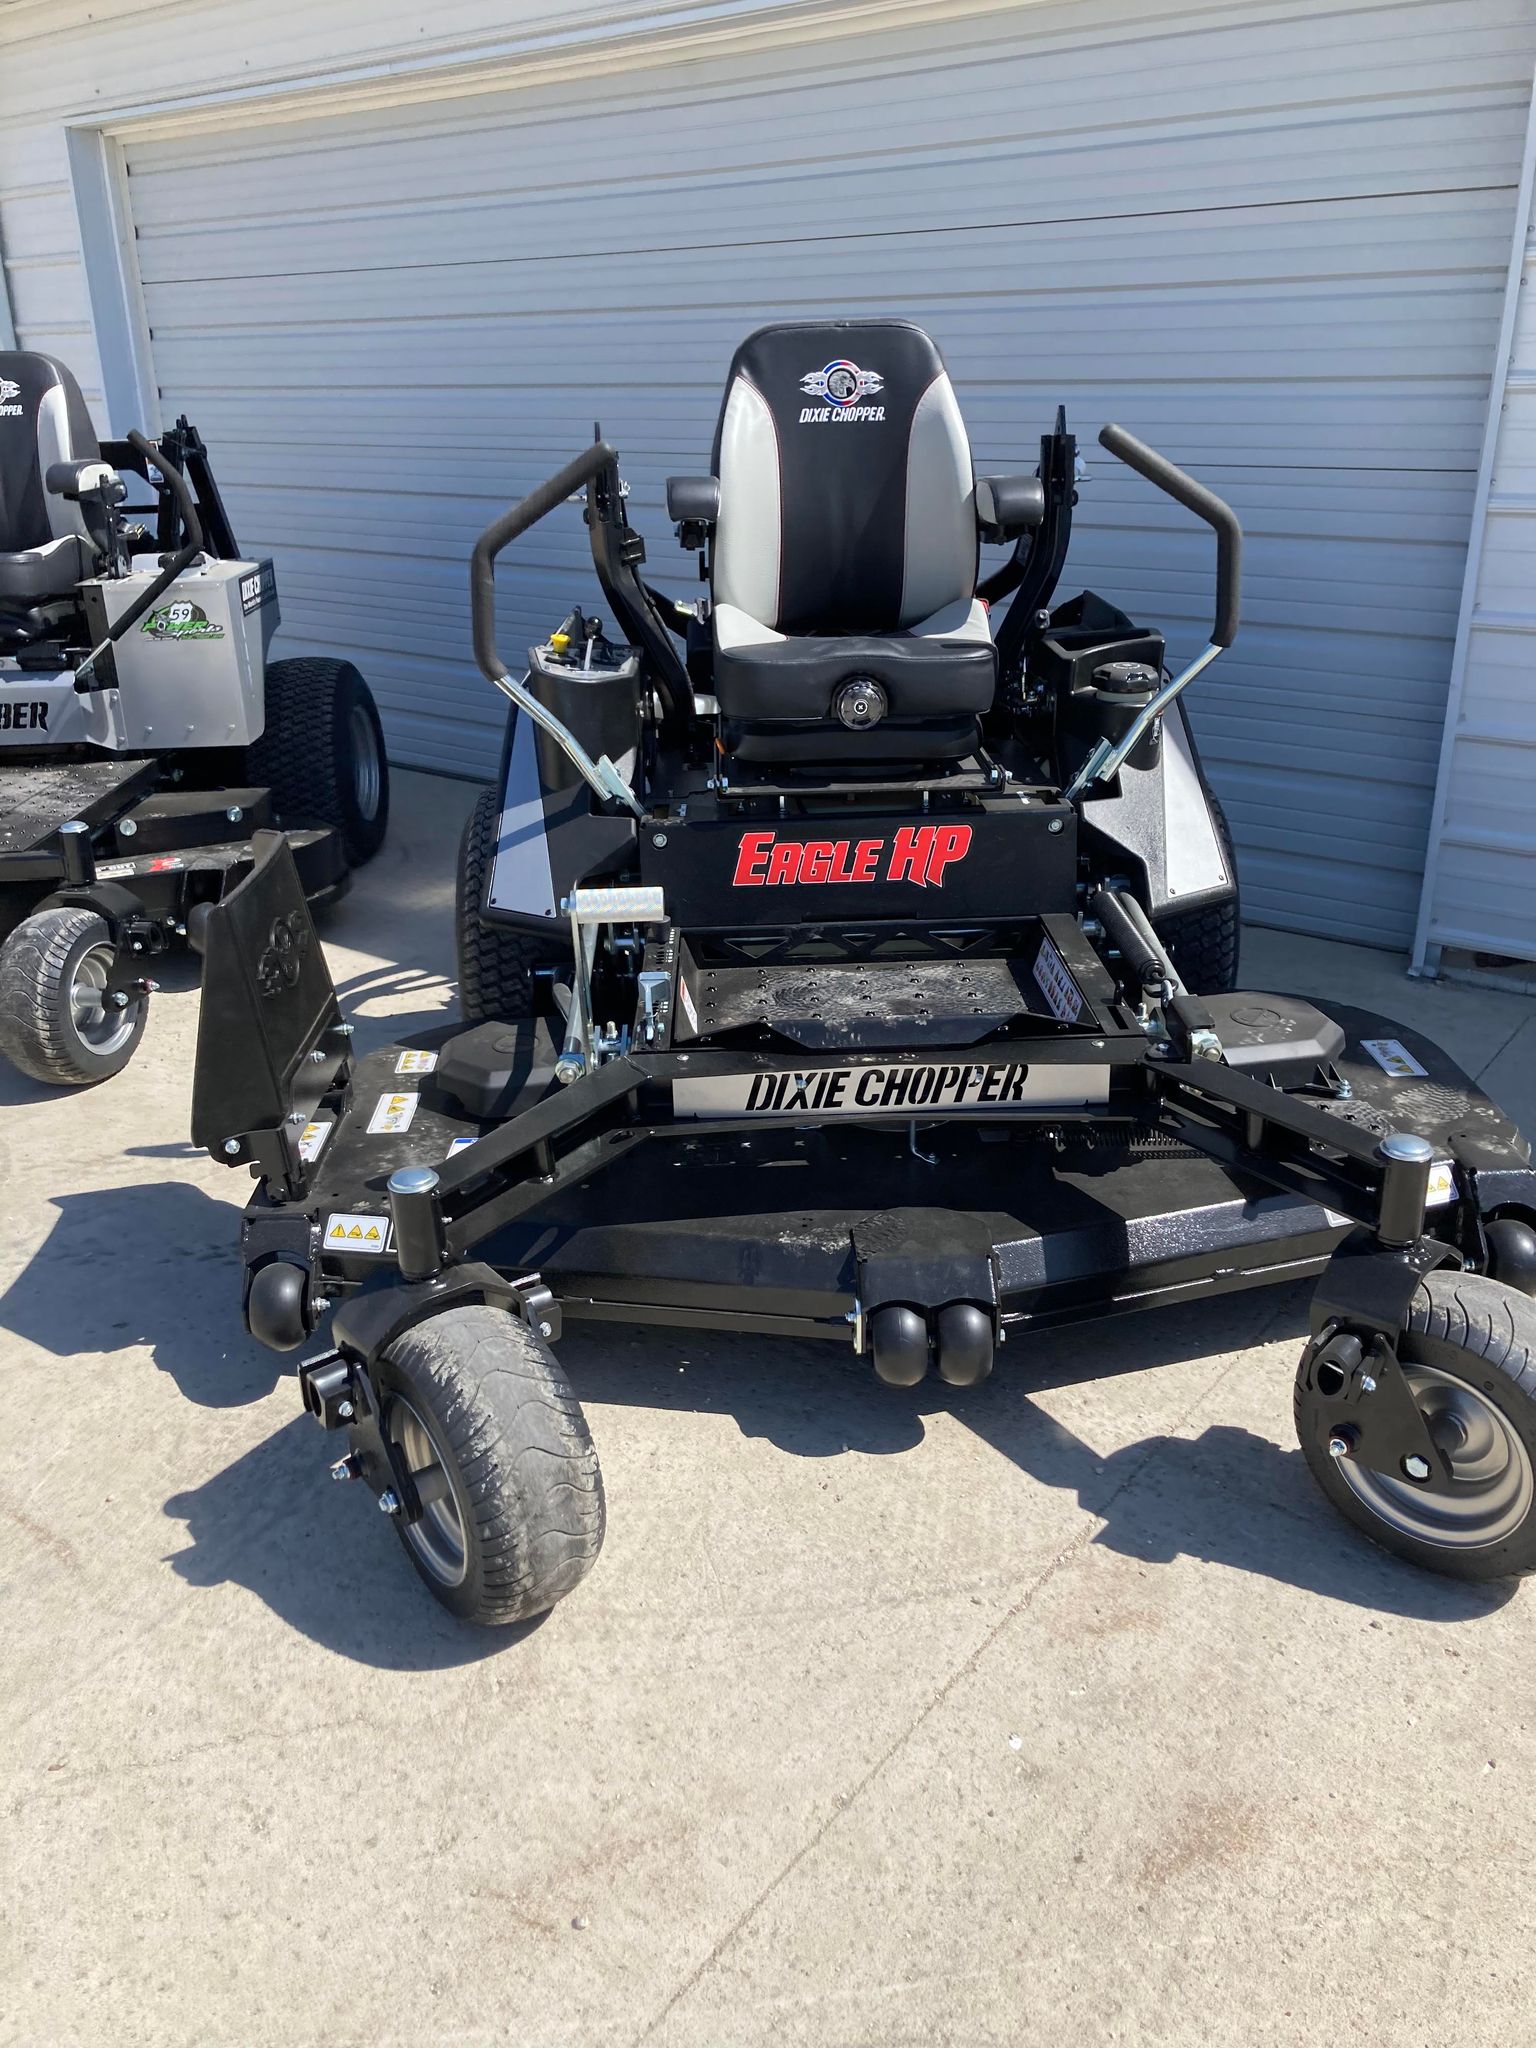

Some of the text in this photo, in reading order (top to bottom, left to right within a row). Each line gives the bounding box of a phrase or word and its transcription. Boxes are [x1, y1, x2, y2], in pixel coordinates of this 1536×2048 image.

[799, 407, 885, 423] DIXIE CHOPPER
[172, 609, 189, 620] 59
[886, 825, 973, 888] HP
[745, 1064, 1029, 1111] DIXIE CHOPPER
